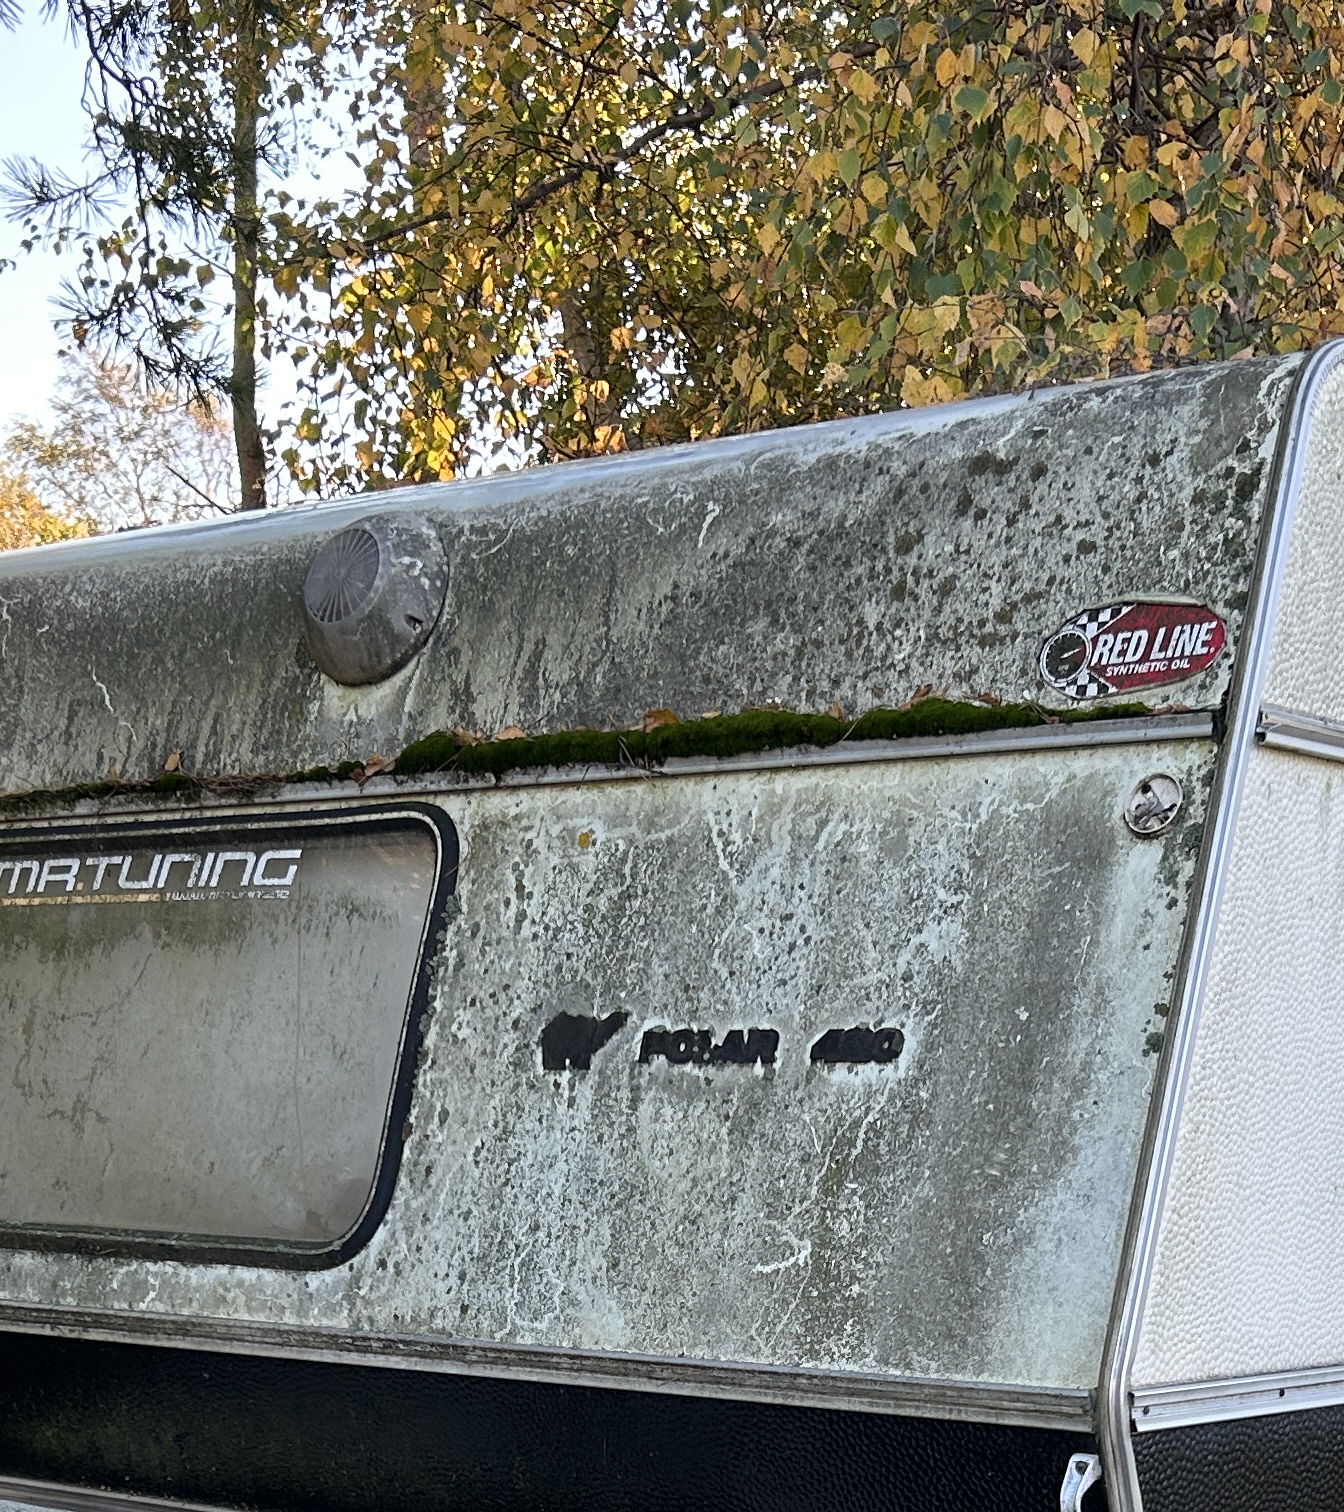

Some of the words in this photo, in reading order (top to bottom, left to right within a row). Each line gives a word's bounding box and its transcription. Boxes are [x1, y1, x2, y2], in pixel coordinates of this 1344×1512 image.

[1090, 628, 1148, 667] RED
[1150, 621, 1218, 661] LINE
[1105, 659, 1169, 677] SYNTHETIC
[1171, 658, 1191, 670] OIL
[638, 1027, 780, 1065] POLAR
